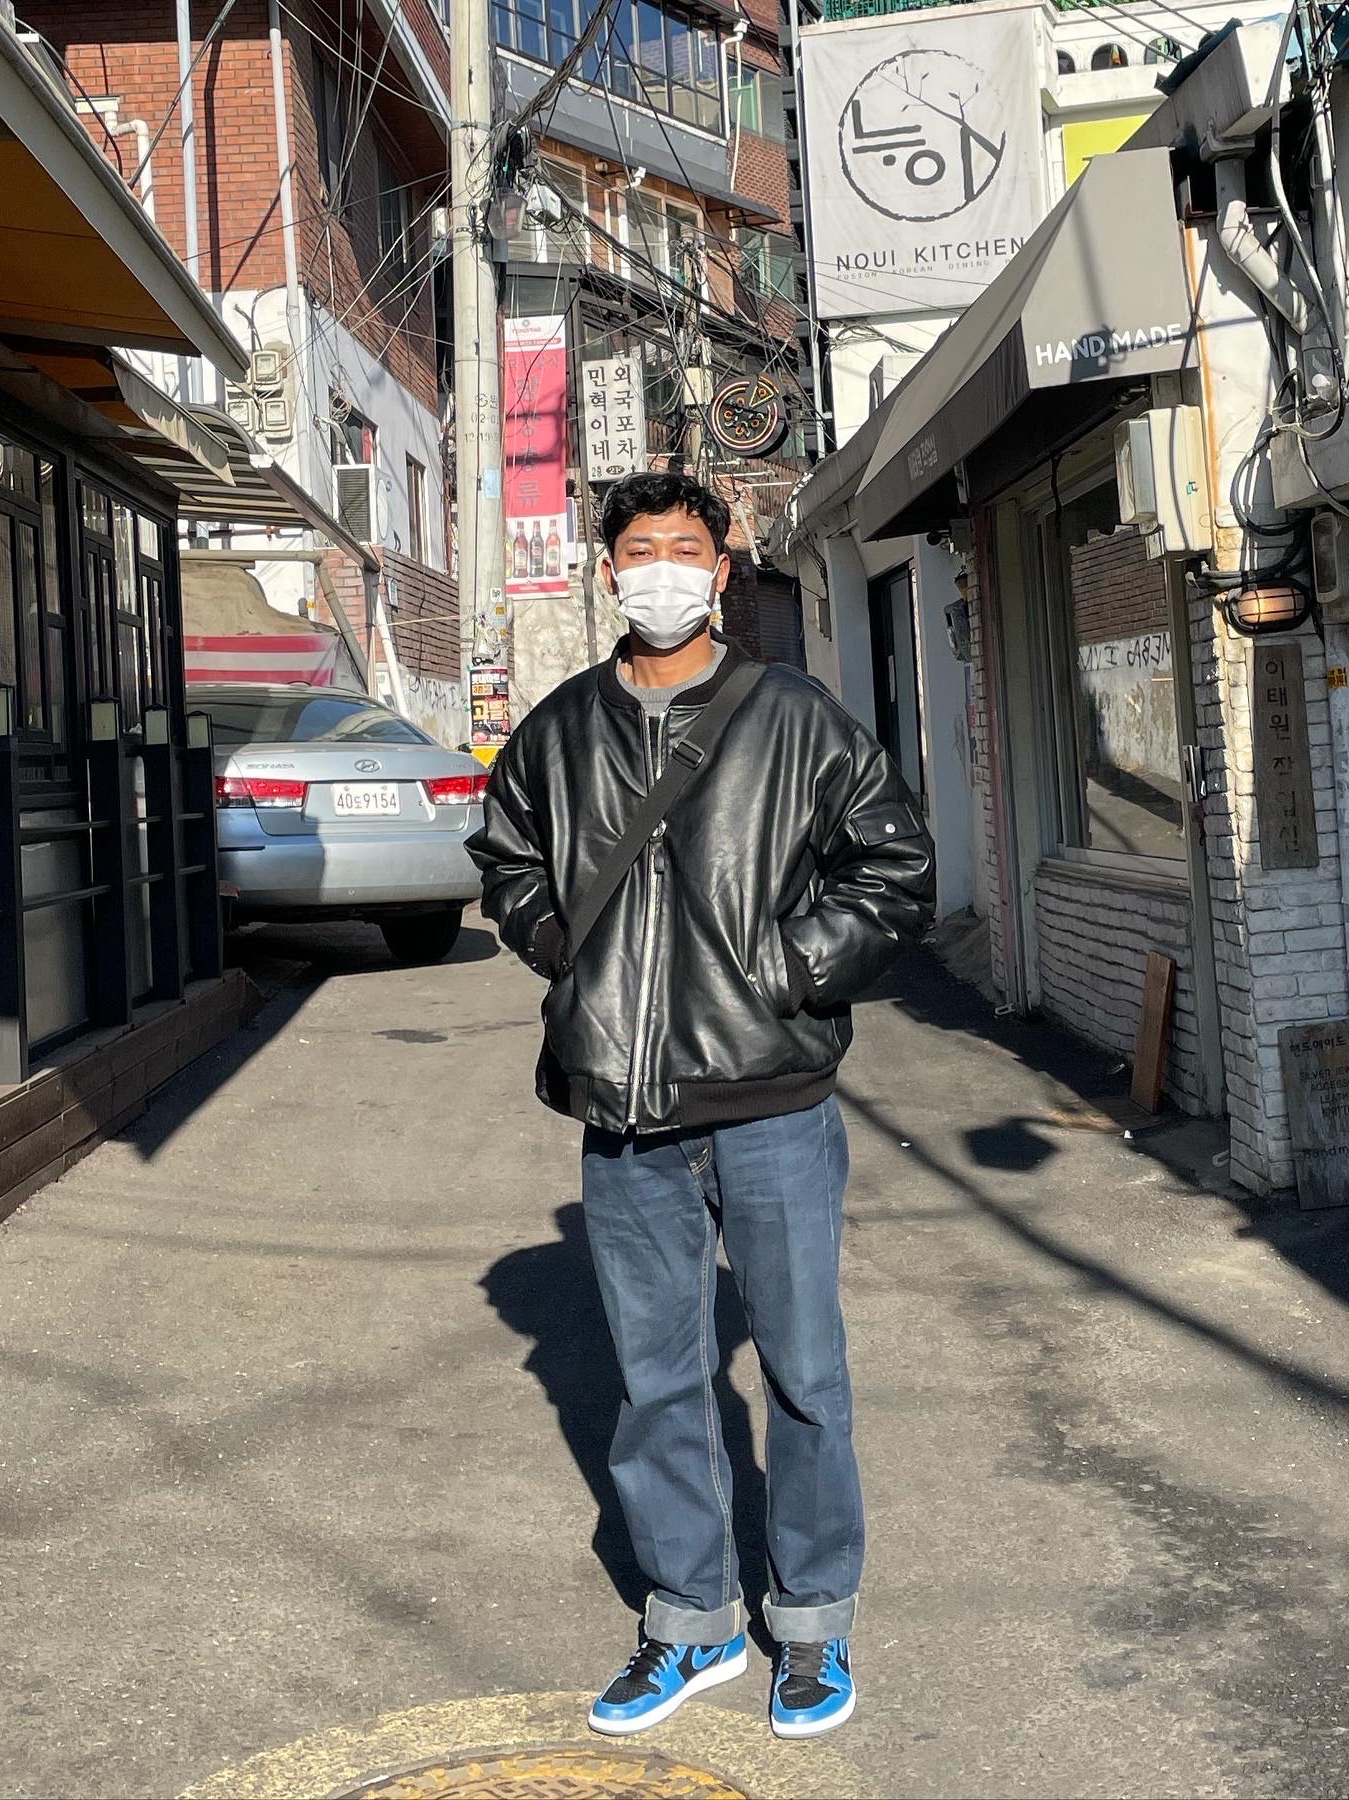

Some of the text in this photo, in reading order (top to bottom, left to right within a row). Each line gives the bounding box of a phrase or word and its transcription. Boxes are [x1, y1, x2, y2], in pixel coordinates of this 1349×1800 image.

[836, 236, 1024, 272] NOUI KITCHEN
[948, 260, 989, 271] DINING
[1035, 323, 1183, 366] HAND MADE
[588, 366, 609, 461] 민혁이네
[614, 364, 638, 460] 외국포차
[1265, 660, 1291, 740] 이태원
[337, 792, 397, 809] 40도9154
